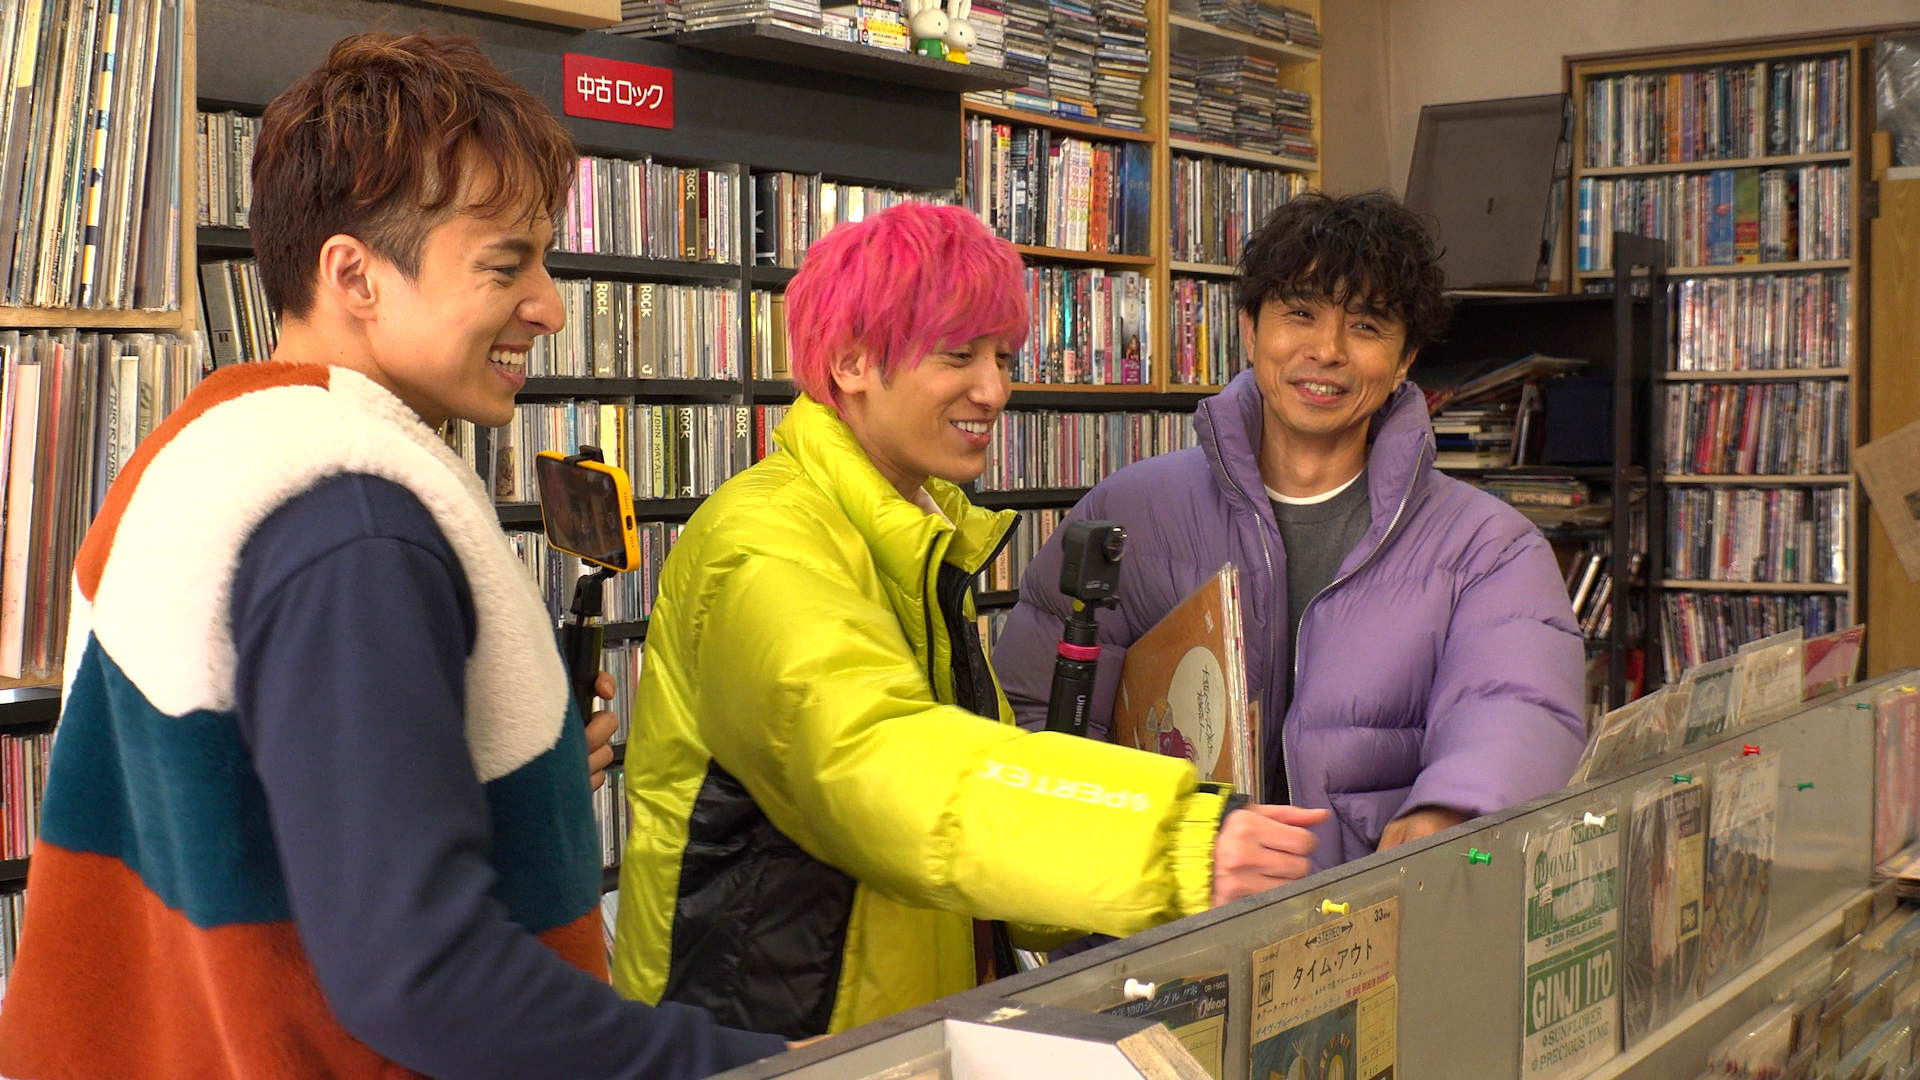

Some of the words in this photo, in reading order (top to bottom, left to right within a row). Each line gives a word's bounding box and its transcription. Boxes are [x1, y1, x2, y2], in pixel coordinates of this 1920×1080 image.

[577, 72, 612, 103] 中古
[616, 80, 663, 109] ロック
[686, 169, 696, 200] ROCK
[687, 247, 695, 257] H
[596, 283, 608, 315] ROCK
[640, 285, 652, 317] ROCK
[653, 411, 661, 438] JOHN
[680, 408, 691, 438] ROCK
[736, 408, 747, 438] ROCK
[653, 443, 661, 483] MAYALL
[1074, 694, 1086, 726] Ulanzi
[1549, 849, 1579, 878] ONLY
[1317, 925, 1341, 944] STEREO
[1566, 917, 1603, 940] RELEASE
[1293, 938, 1373, 990] タイム・アウト
[1532, 967, 1581, 1031] GINJI
[1586, 949, 1613, 1005] ITO
[1197, 997, 1227, 1018] Odeon
